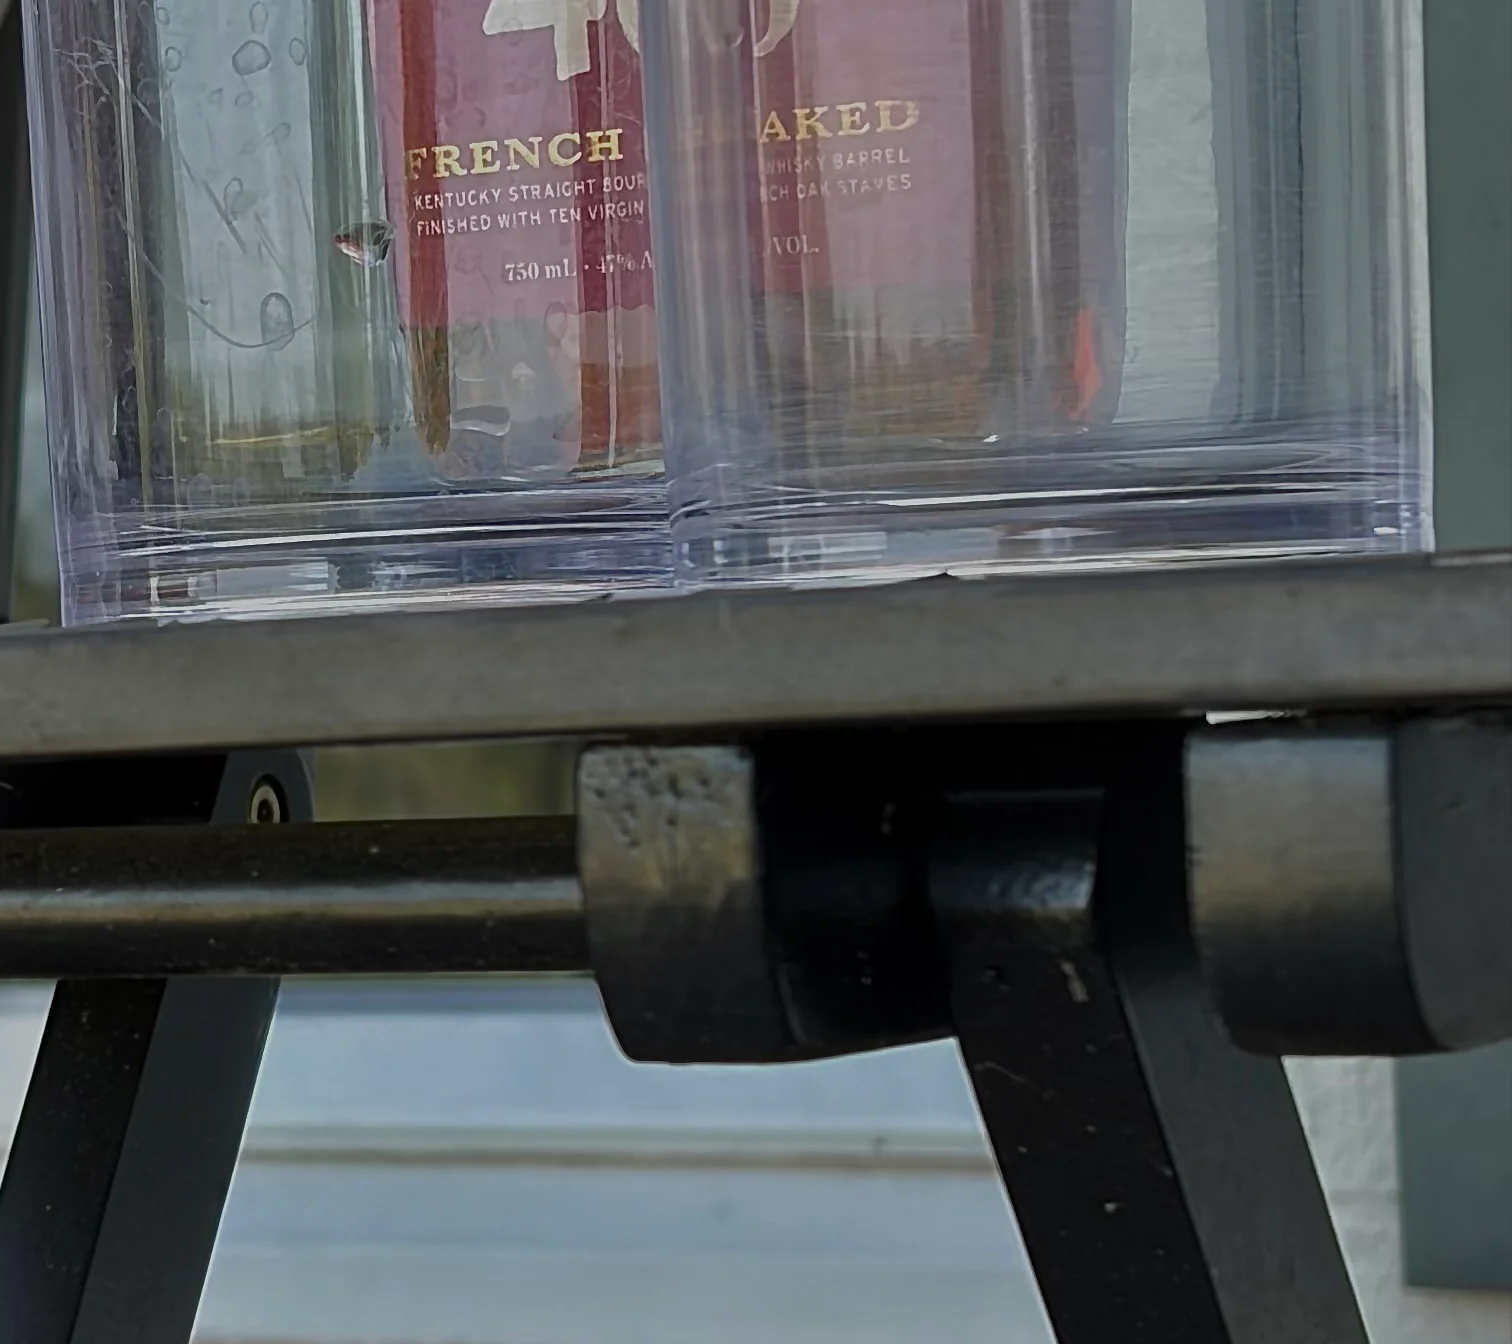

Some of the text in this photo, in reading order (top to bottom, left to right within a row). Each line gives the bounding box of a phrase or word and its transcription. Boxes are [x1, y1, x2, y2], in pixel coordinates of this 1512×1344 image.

[405, 100, 920, 181] FRENCH AKED
[414, 187, 502, 211] KENTUCKY
[509, 178, 596, 203] STRAIGHT
[602, 172, 648, 193] BOUR
[832, 147, 911, 170] BARREL
[417, 214, 491, 238] FINISHED
[498, 210, 541, 230] WITH
[550, 207, 581, 224] TEN
[587, 200, 644, 220] VIRGIN
[796, 179, 832, 201] OAK
[837, 174, 912, 195] STAVES
[504, 261, 540, 282] 750
[544, 258, 577, 280] mL
[772, 233, 820, 255] VOL.
